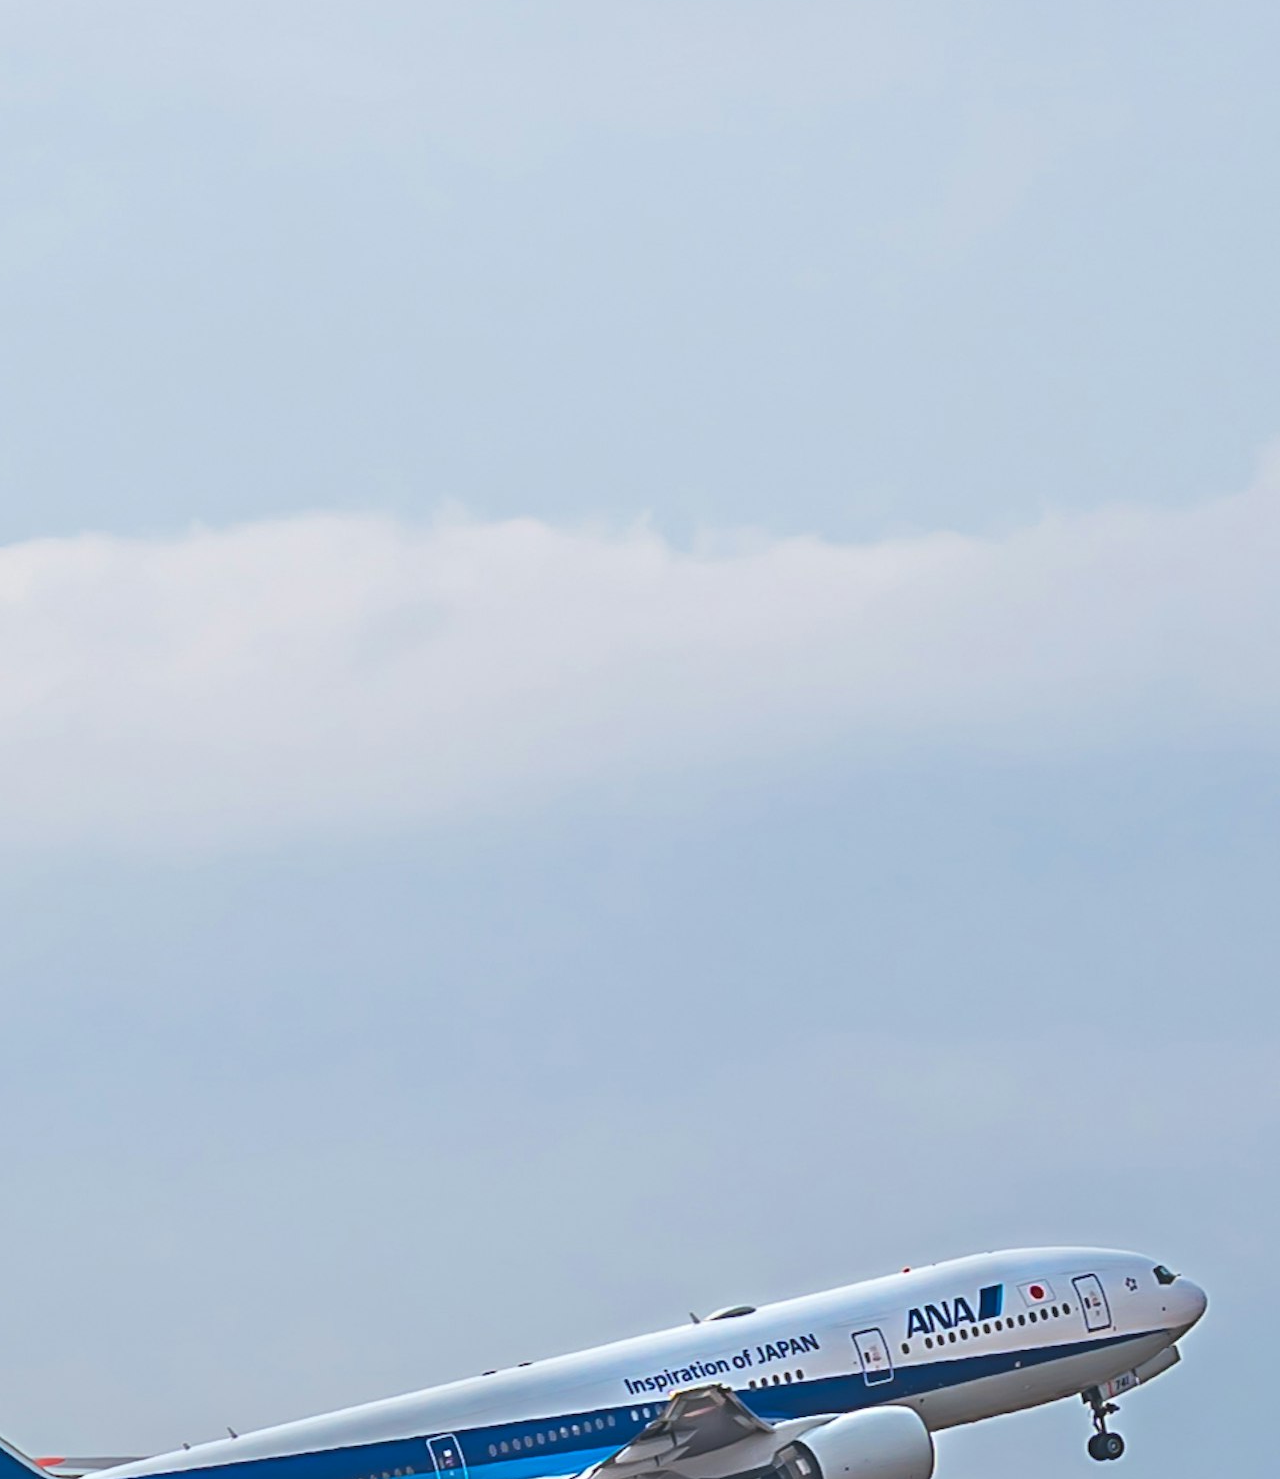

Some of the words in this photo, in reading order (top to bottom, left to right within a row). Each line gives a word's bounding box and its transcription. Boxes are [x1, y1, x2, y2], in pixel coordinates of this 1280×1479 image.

[907, 1297, 977, 1339] ANA
[624, 1359, 730, 1395] Inspiration
[732, 1349, 754, 1369] of
[756, 1333, 821, 1365] JAPAN
